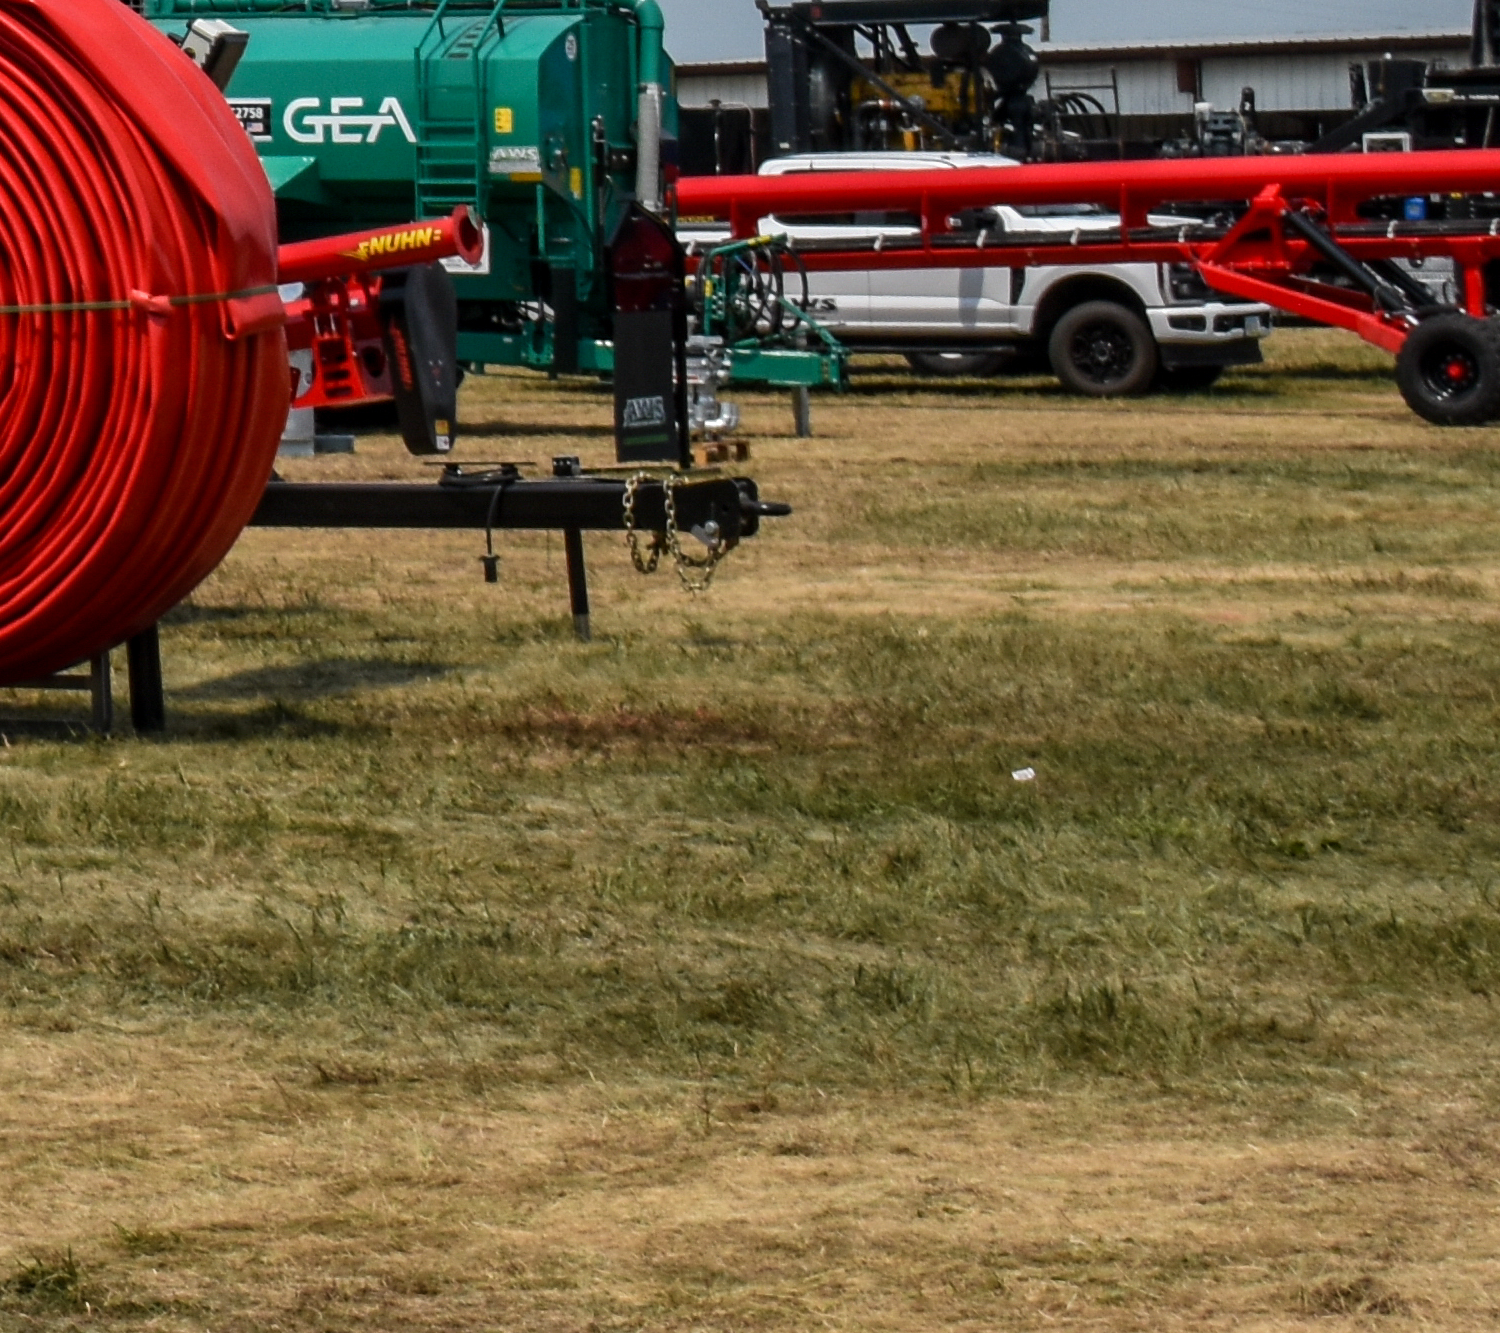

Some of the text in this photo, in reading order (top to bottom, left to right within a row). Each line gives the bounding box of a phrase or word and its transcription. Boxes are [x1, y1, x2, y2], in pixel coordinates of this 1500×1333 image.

[283, 97, 417, 143] GEA
[492, 147, 538, 161] AWS
[364, 226, 436, 258] NUHN
